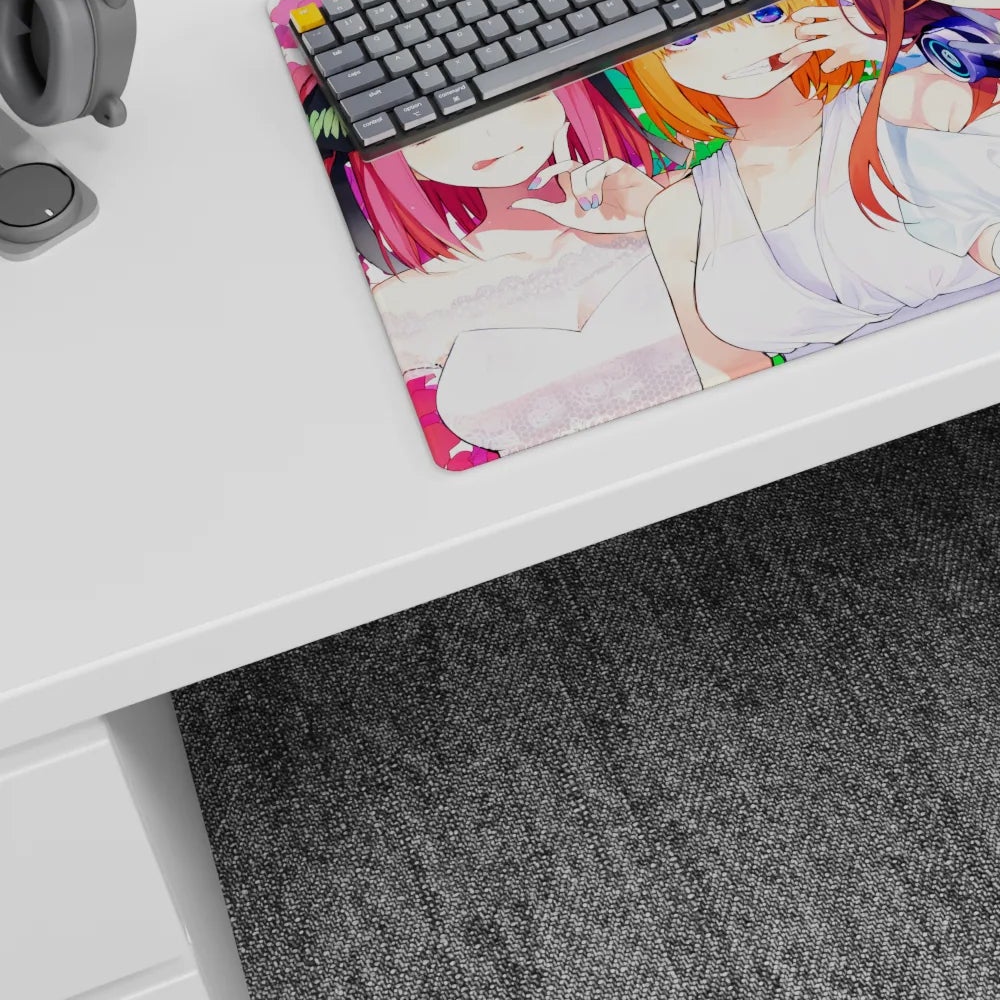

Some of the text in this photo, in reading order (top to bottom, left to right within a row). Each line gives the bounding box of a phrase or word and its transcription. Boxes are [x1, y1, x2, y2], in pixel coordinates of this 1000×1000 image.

[438, 84, 467, 99] command
[402, 101, 423, 113] option
[362, 116, 383, 128] control
